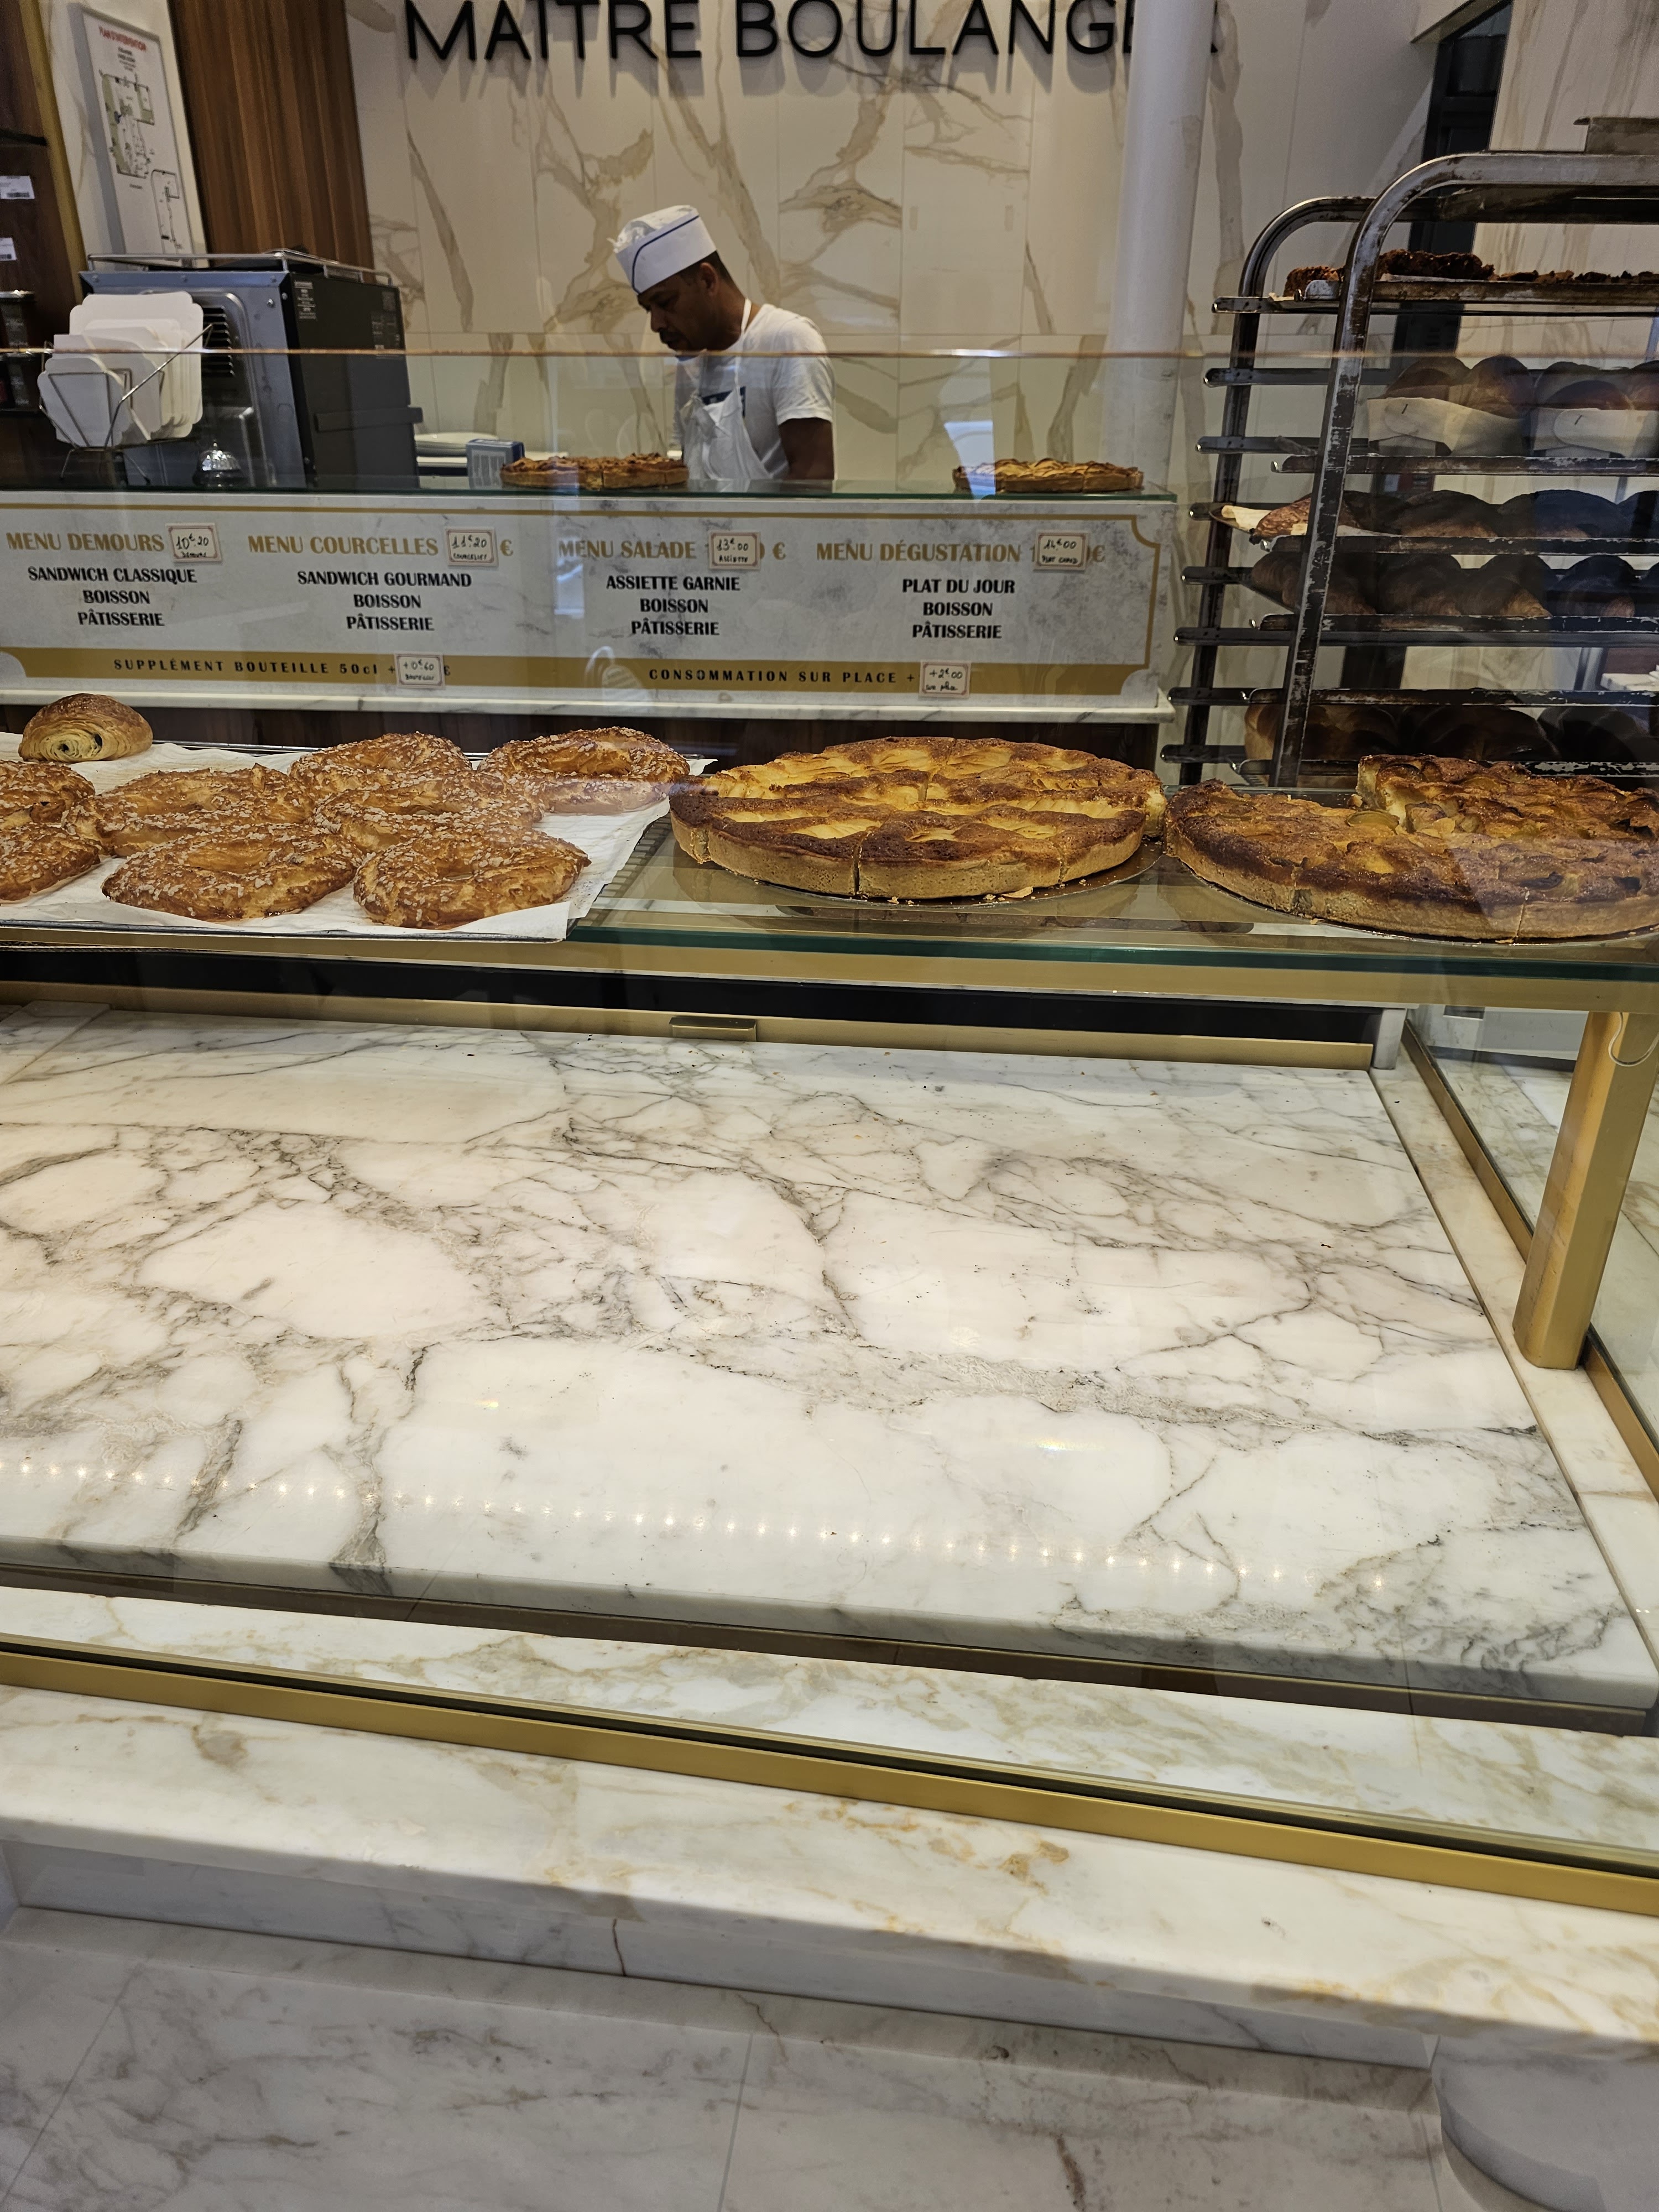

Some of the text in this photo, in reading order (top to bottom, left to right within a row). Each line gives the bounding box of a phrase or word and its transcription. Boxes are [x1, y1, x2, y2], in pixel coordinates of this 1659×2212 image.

[737, 0, 1218, 59] BOULANG
[6, 533, 165, 552] MENU DEMOURS
[248, 535, 514, 557] MENU COURCELLES €
[559, 540, 786, 560] MENU SALADE €
[816, 542, 872, 561] MENU
[880, 539, 1021, 562] DÉGUSTATION
[28, 566, 197, 585] SANDWICH CLASSIQUE
[298, 571, 472, 587] SANDWICH GOURMAND
[606, 575, 740, 591] ASSIETTE GARNIE
[902, 578, 1015, 594] PLAT DU JOUR
[82, 589, 150, 604] BOISSON
[353, 594, 422, 609] BOISSON
[640, 598, 708, 613] BOISSON
[77, 609, 165, 627] PÂTISSERIE
[923, 602, 993, 616] BOISSON
[347, 613, 435, 631] PÂTISSERIE
[632, 618, 720, 636] PÂTISSERIE
[912, 621, 1002, 639] PÂTISSERIE
[114, 658, 223, 671] SUPPLÉMENT
[234, 661, 329, 674] BOUTEILLE
[340, 663, 378, 675] 50cl
[649, 669, 787, 682] CONSOMMATION
[799, 670, 832, 683] SUR
[842, 671, 896, 684] PLACE
